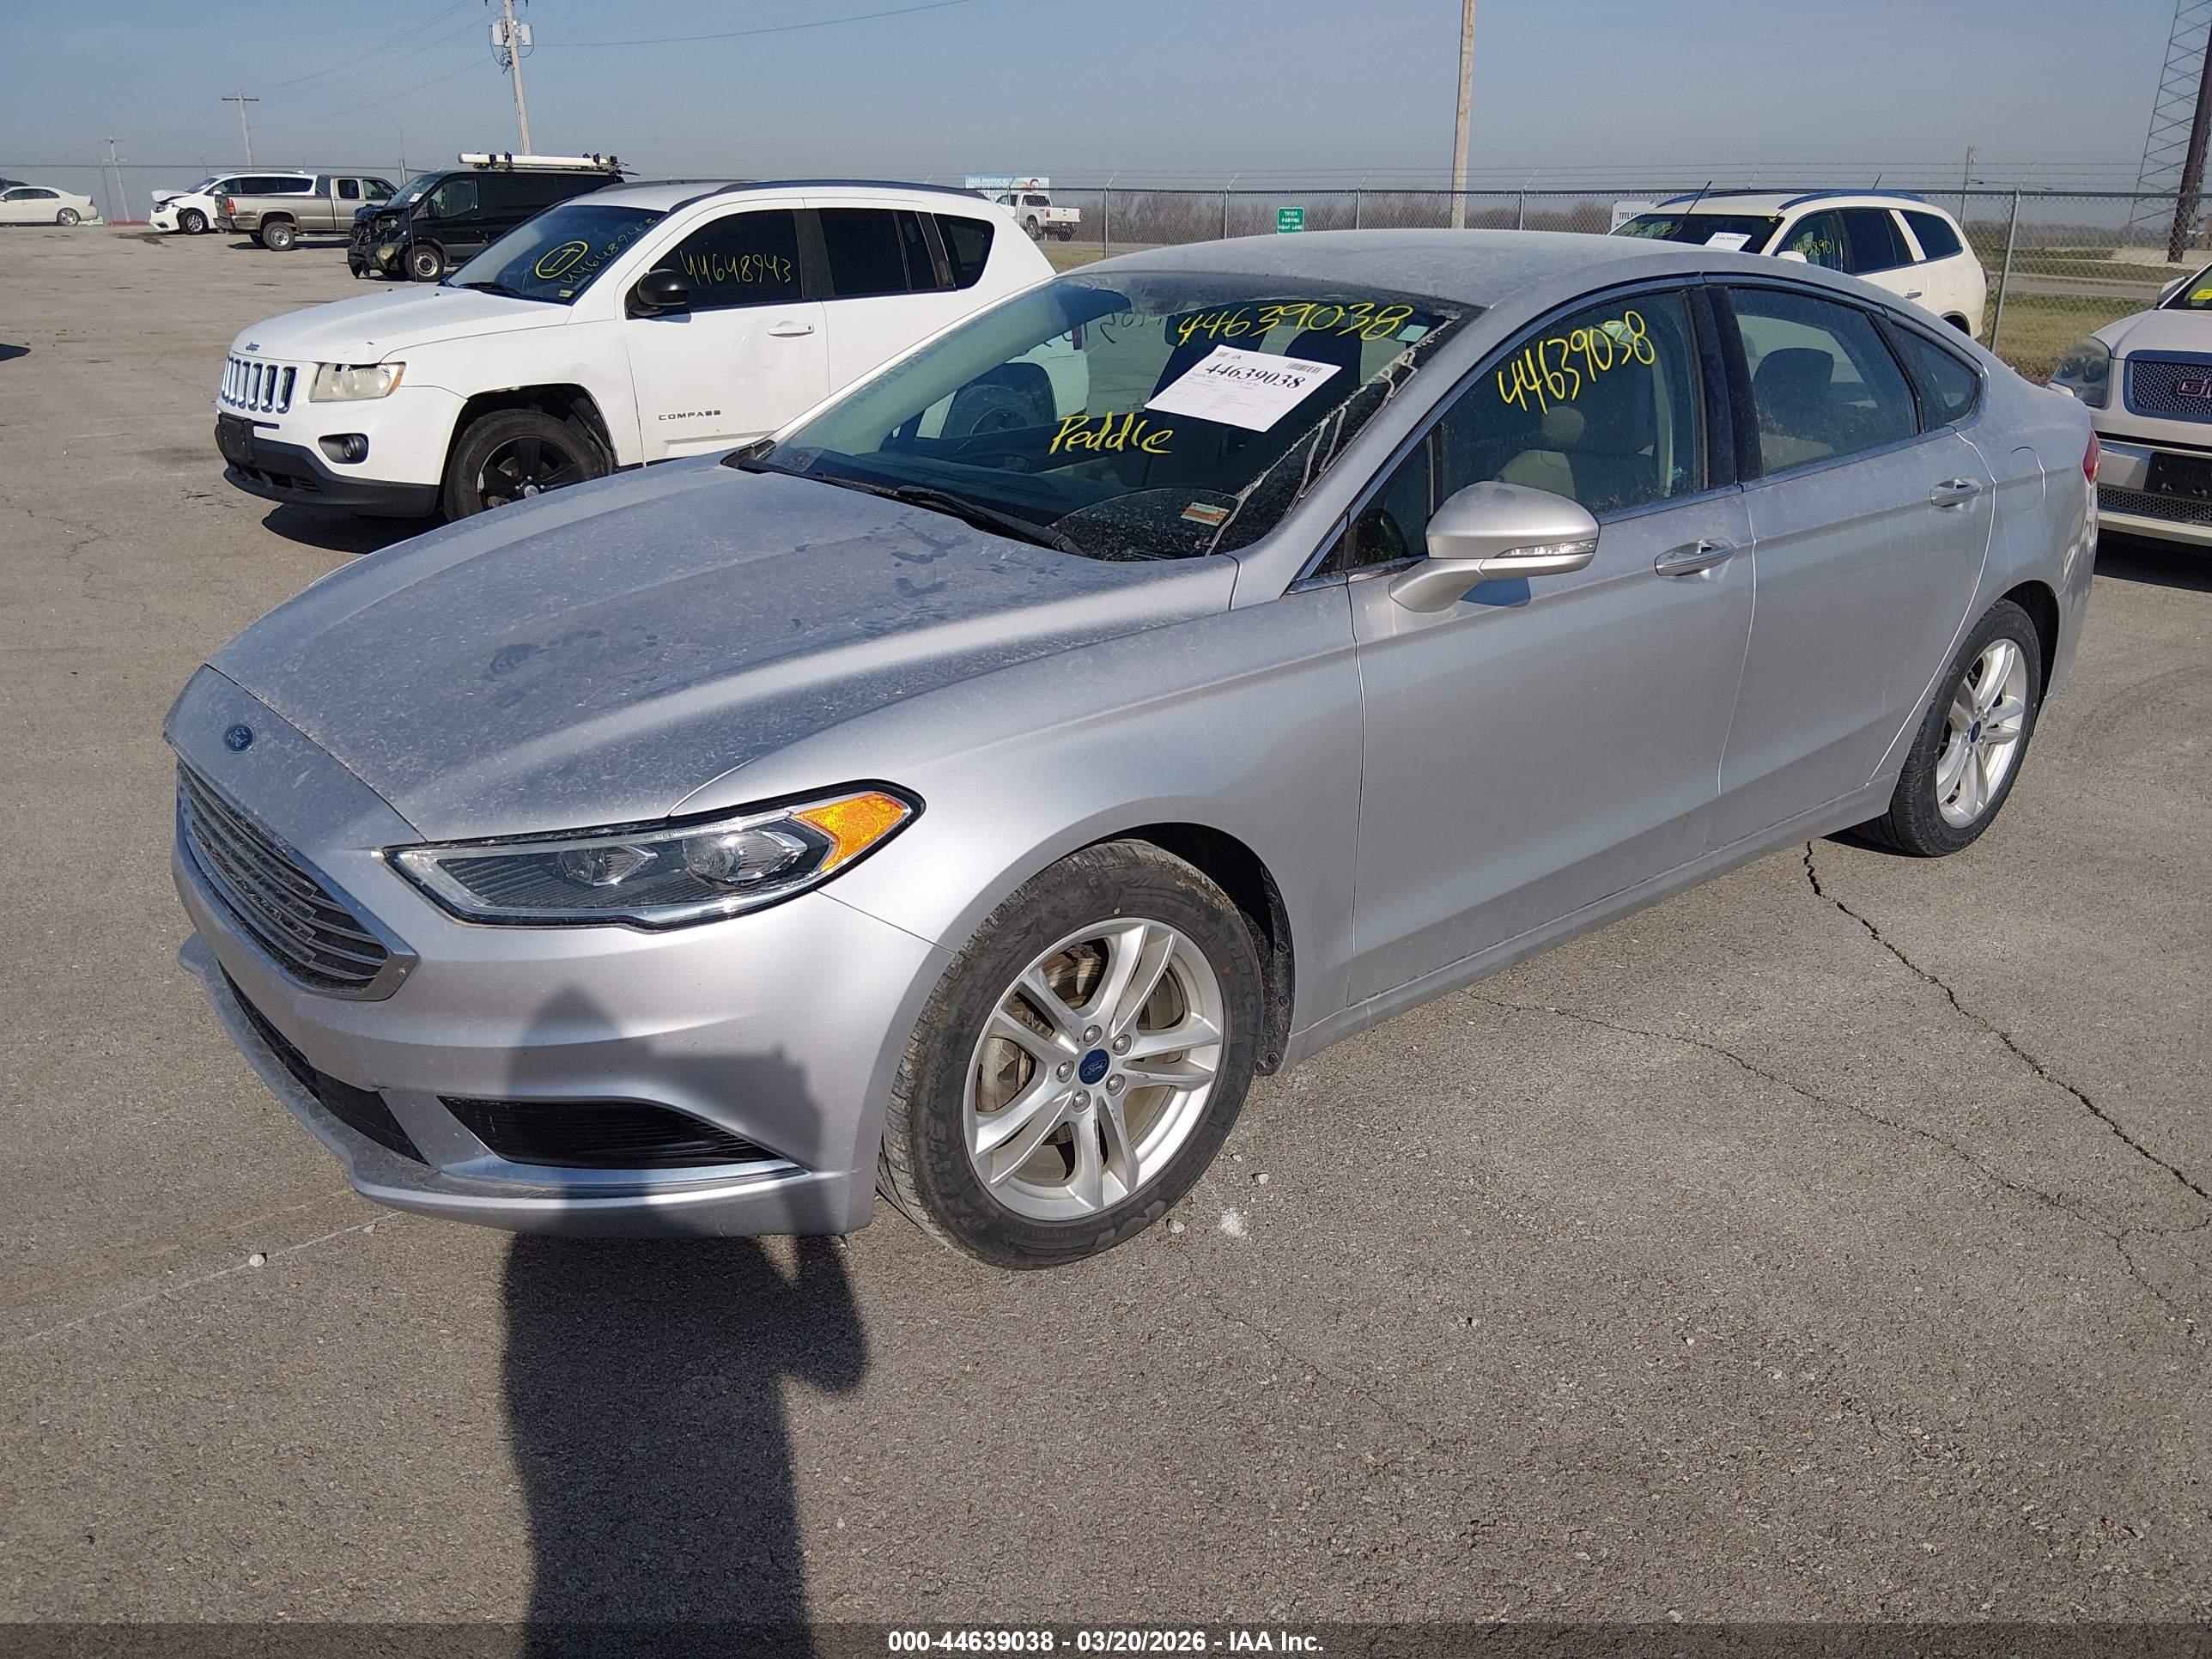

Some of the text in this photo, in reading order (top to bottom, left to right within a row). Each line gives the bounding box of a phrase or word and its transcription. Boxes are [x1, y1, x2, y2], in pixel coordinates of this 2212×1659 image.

[680, 249, 792, 286] 44648943
[1177, 302, 1414, 347] 44639038
[1205, 363, 1306, 390] 44639038
[1498, 310, 1656, 416] 44639038
[658, 410, 721, 421] COMPASS
[1048, 410, 1175, 456] Peddle
